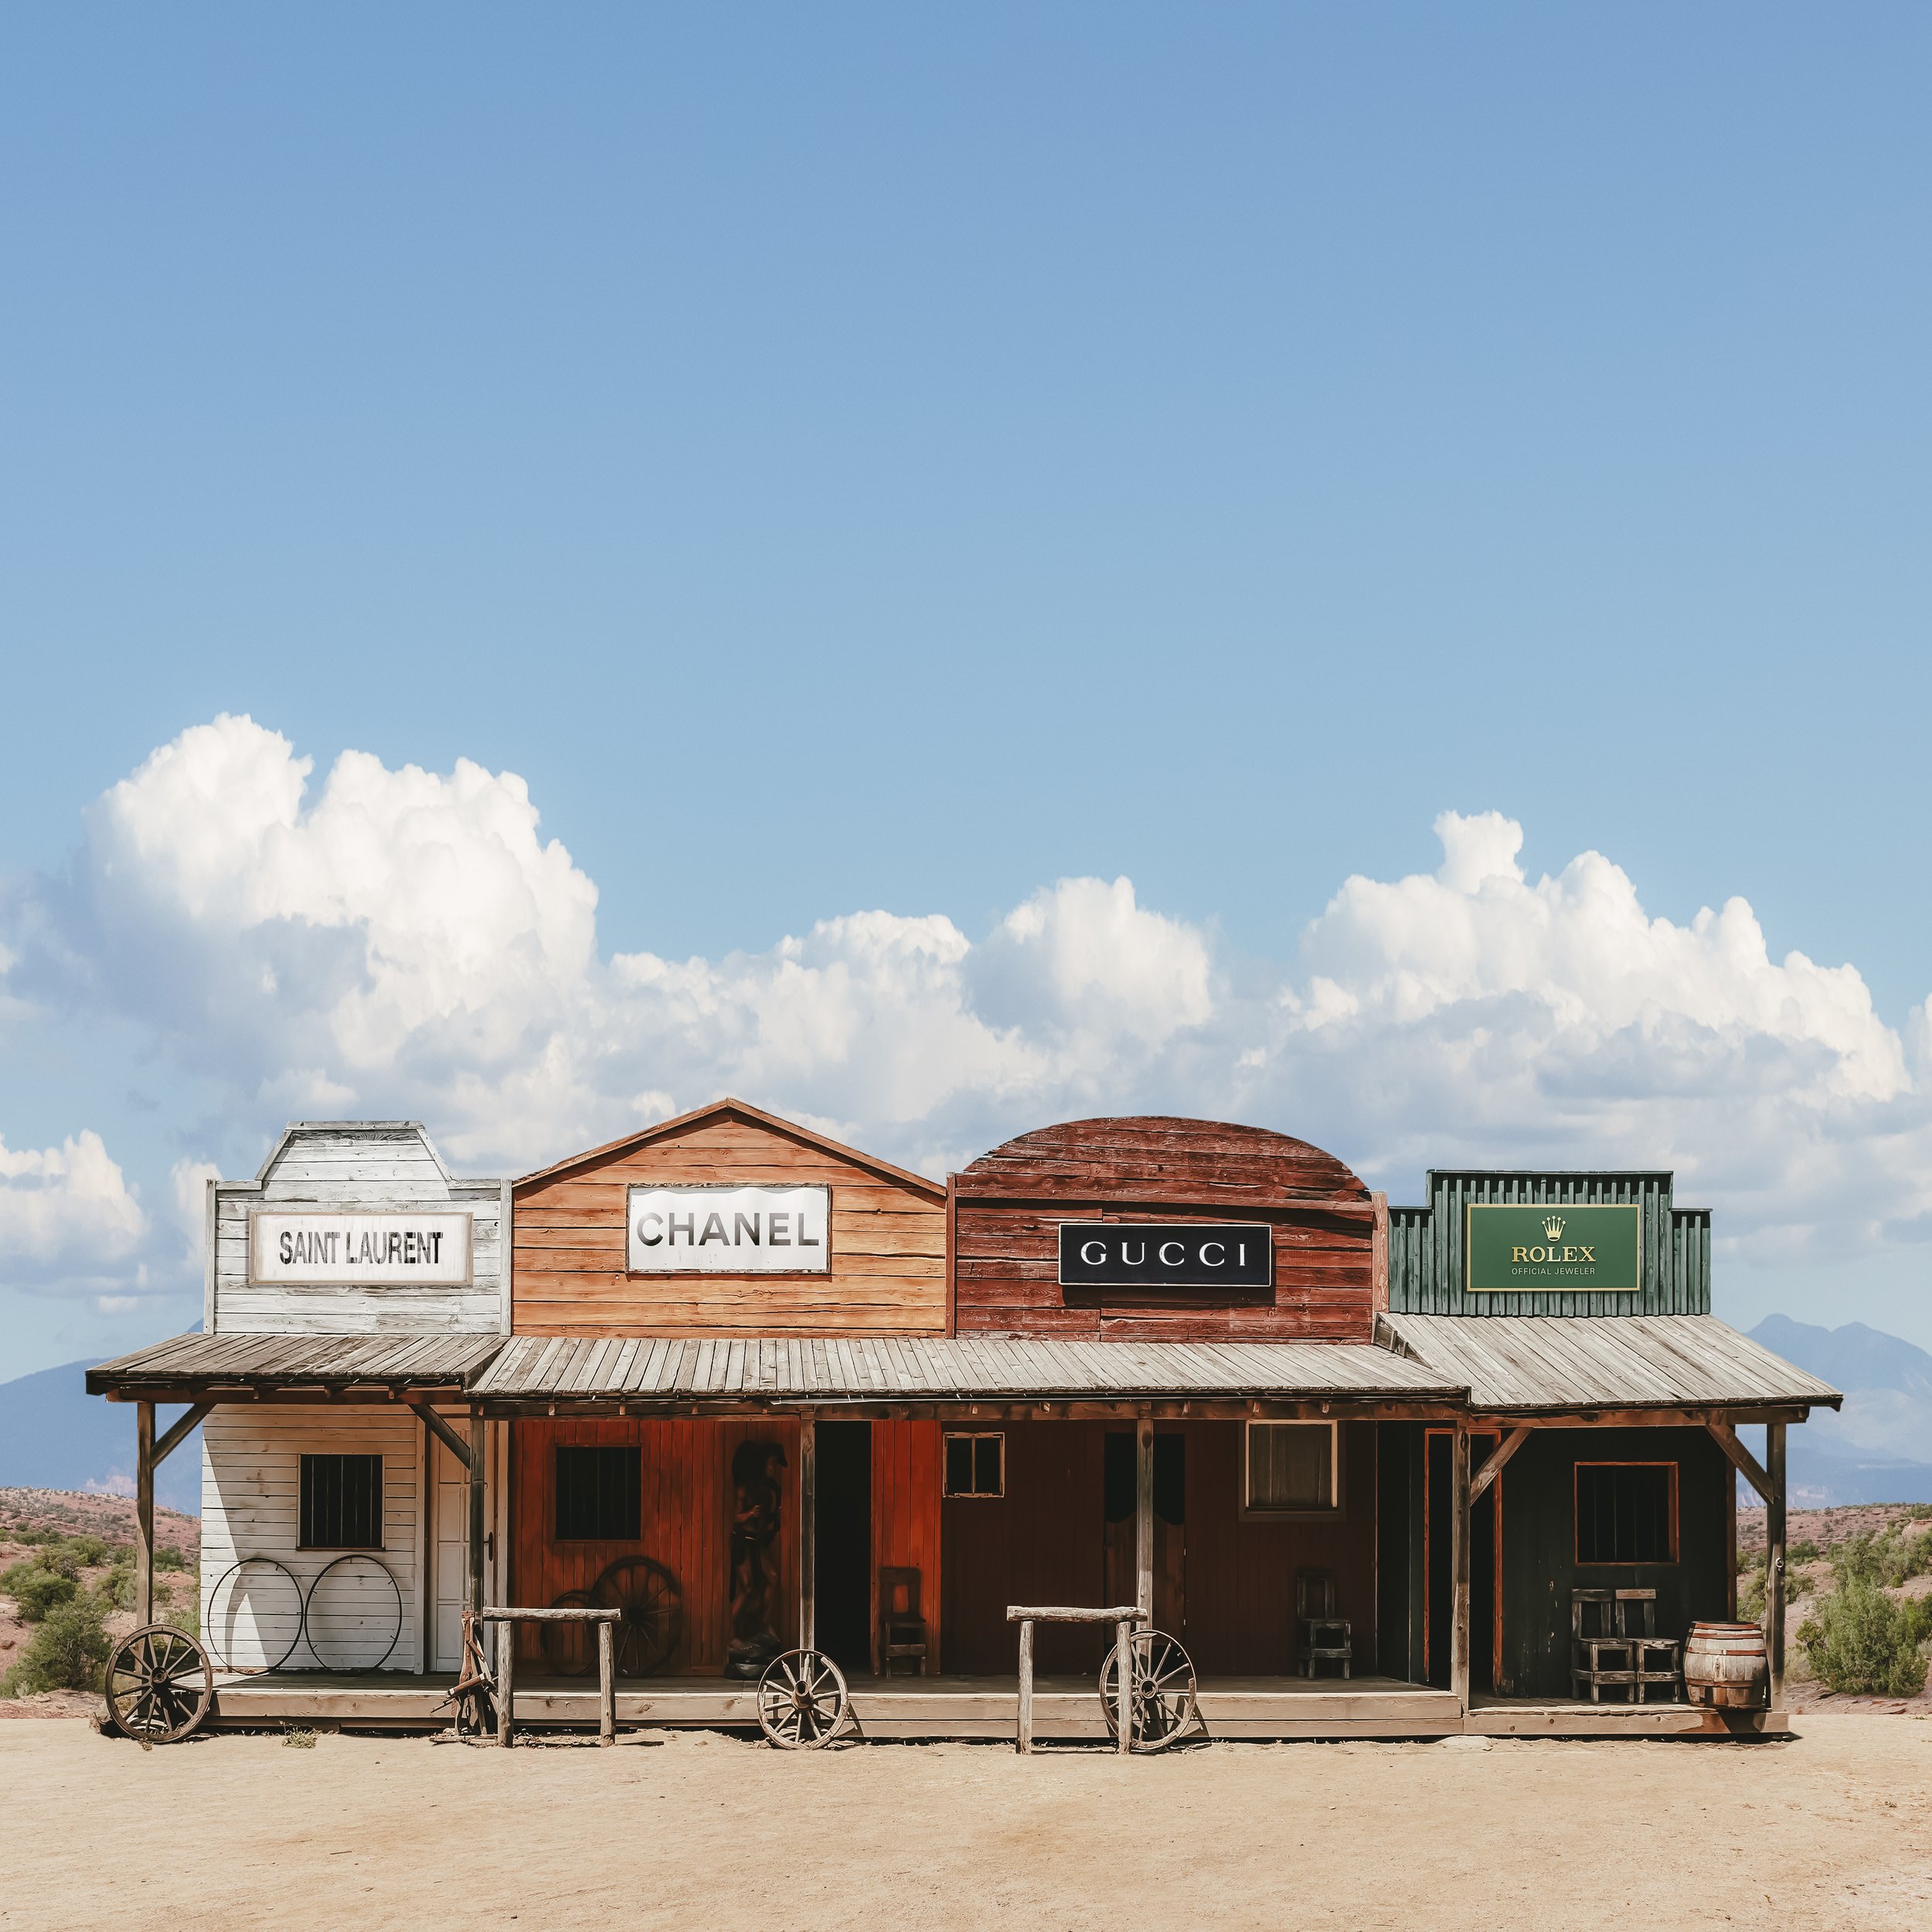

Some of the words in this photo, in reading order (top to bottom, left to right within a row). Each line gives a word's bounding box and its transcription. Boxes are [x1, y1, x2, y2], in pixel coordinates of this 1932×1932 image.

[637, 1213, 819, 1247] CHANEL
[279, 1231, 340, 1264] SAINT
[346, 1231, 444, 1264] LAURENT
[1080, 1241, 1246, 1267] GUCCI
[1512, 1247, 1596, 1262] ROLEX
